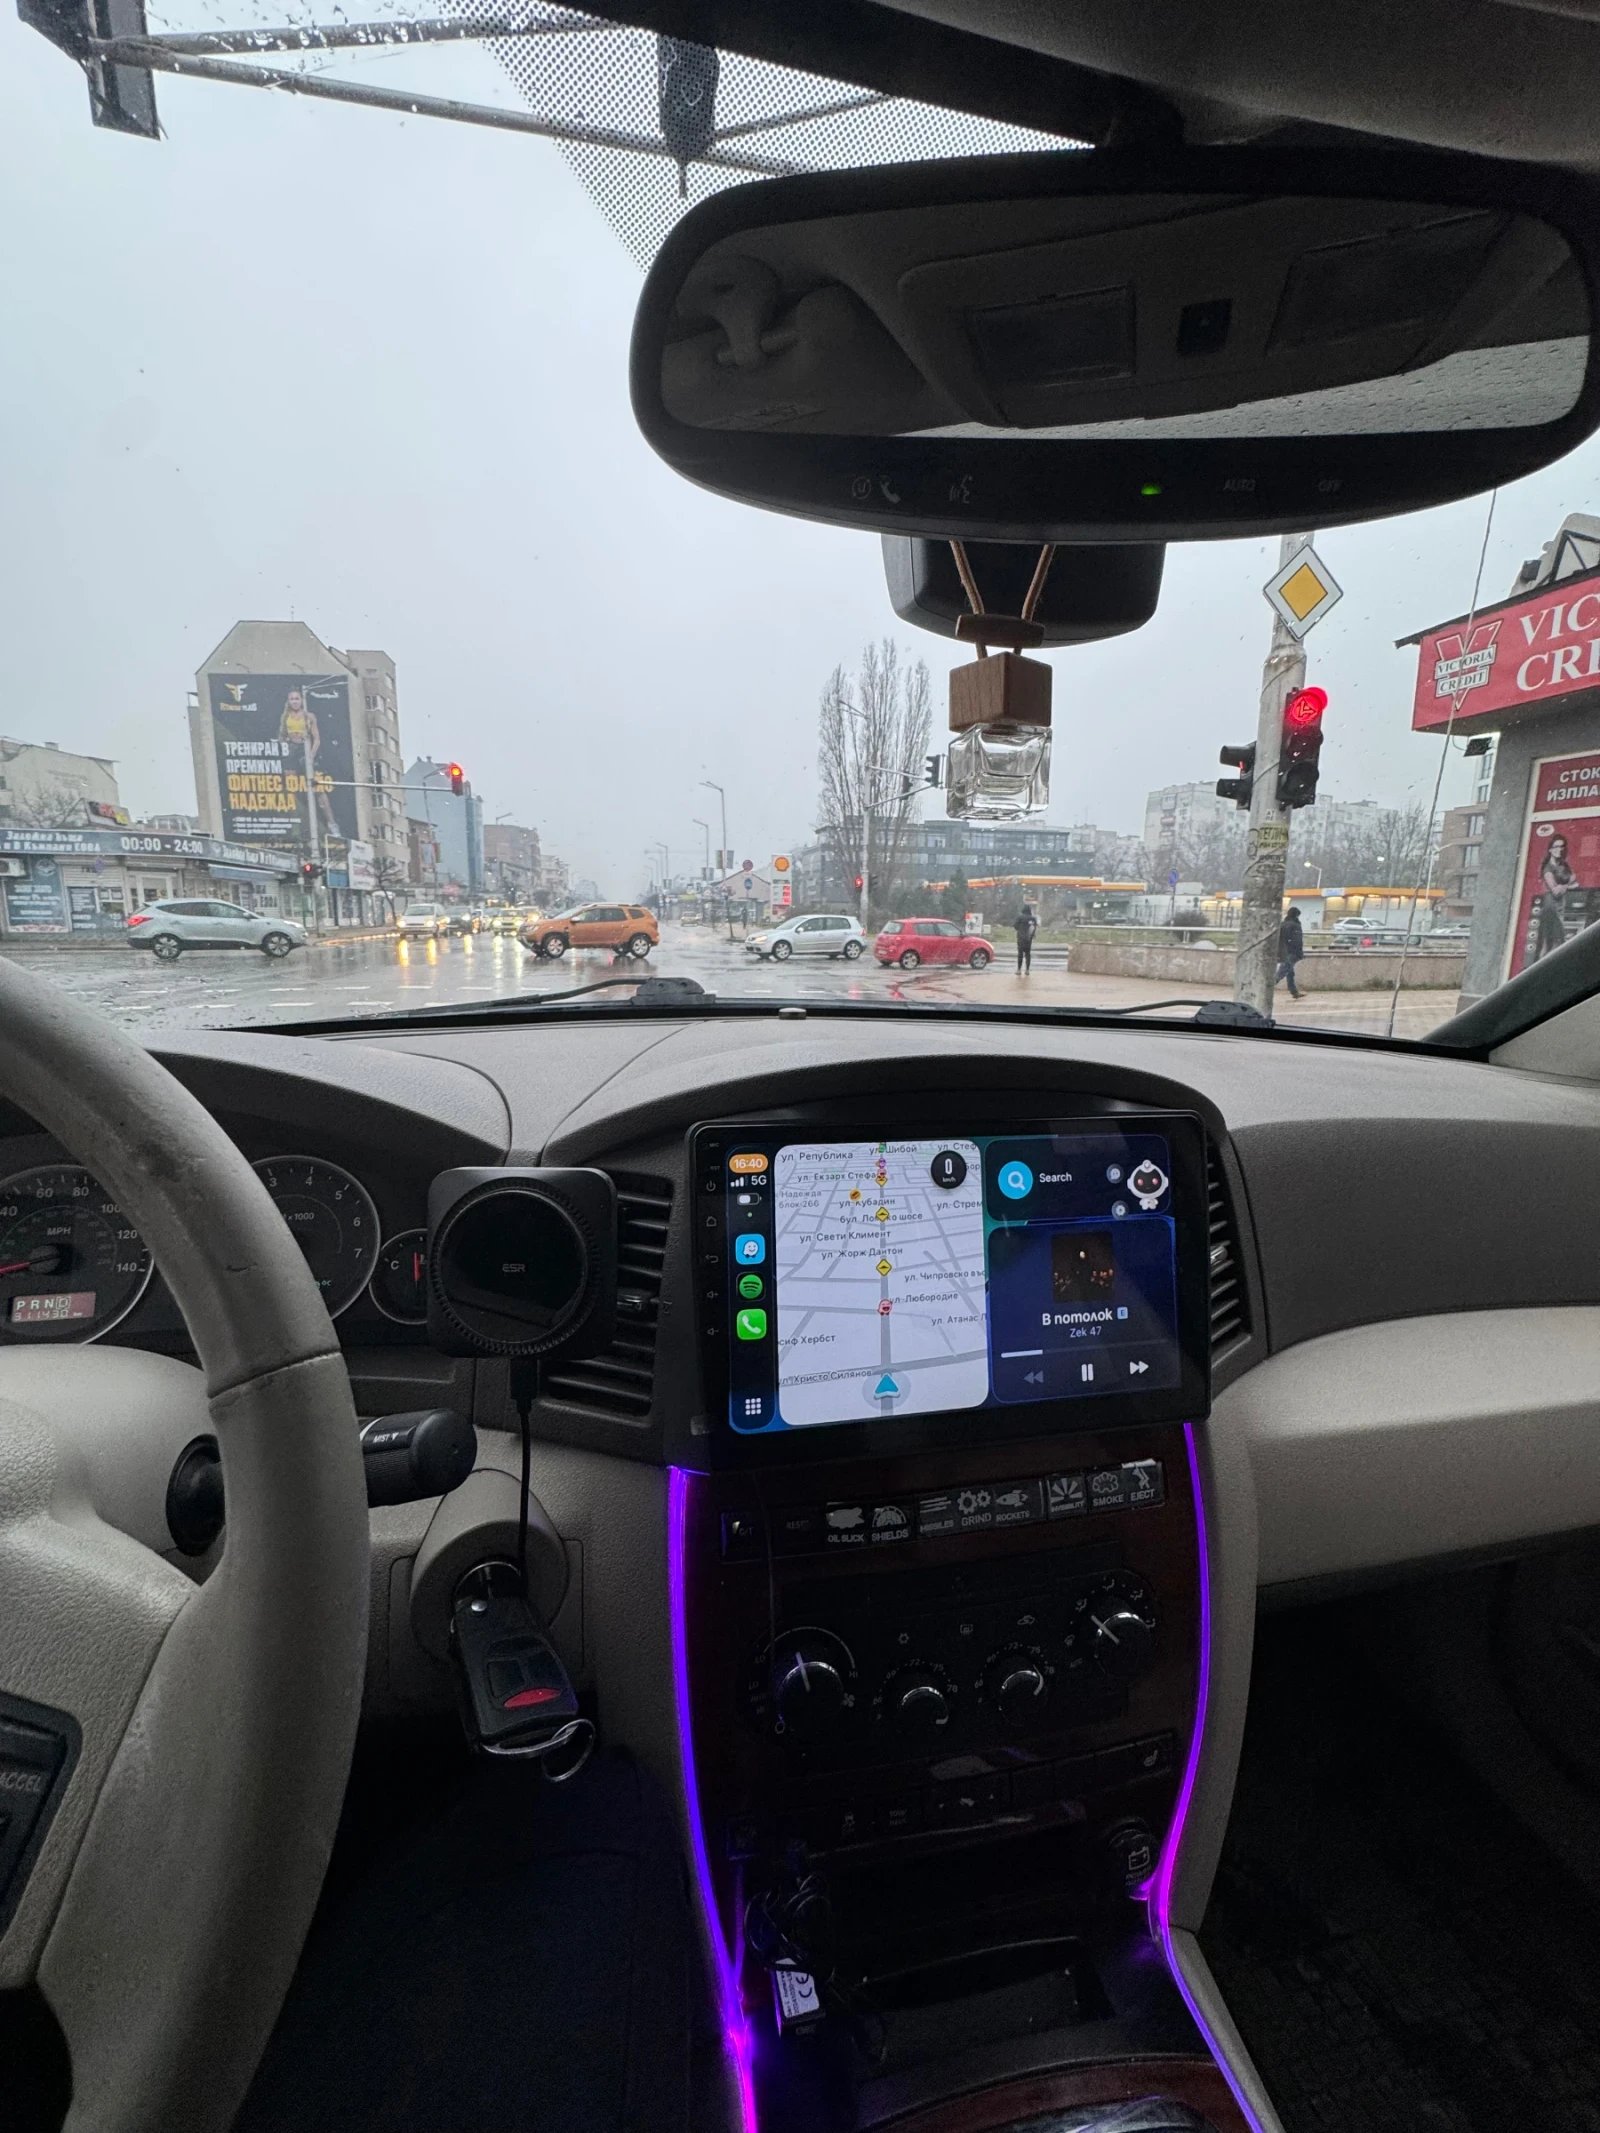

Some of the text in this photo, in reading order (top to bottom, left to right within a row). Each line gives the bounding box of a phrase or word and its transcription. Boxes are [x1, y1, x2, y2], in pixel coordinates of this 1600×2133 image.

[1438, 650, 1493, 674] VICTORIA
[1440, 671, 1485, 692] CREDIT
[224, 738, 290, 757] ТРЕНИРАЙ В
[226, 759, 282, 775] ПРЕМИУМ
[228, 775, 283, 793] ФИТНЕС
[1547, 784, 1600, 802] ИЗПЛА
[229, 792, 297, 812] НАДЕЖДА
[120, 836, 161, 851] 00:00
[174, 839, 204, 854] 24:00
[800, 1151, 854, 1162] Република
[733, 1158, 764, 1169] 16:40
[944, 1158, 953, 1175] 0
[269, 1177, 278, 1187] 3
[305, 1176, 313, 1186] 4
[751, 1175, 767, 1185] 5G
[813, 1172, 845, 1182] Екзарх
[847, 1171, 876, 1180] Стефа
[1039, 1172, 1073, 1183] Search
[36, 1187, 53, 1198] 60
[72, 1186, 89, 1197] 80
[335, 1190, 343, 1201] 5
[781, 1190, 822, 1199] Надежда
[779, 1200, 820, 1208] блок 266
[855, 1198, 896, 1207] Кубадин
[0, 1205, 18, 1217] 40
[294, 1211, 315, 1221] 1000
[899, 1212, 923, 1221] шосе
[353, 1216, 361, 1227] 6
[46, 1227, 72, 1236] MPH
[117, 1229, 138, 1240] 120
[816, 1232, 847, 1242] Свети
[848, 1231, 891, 1240] Климент
[353, 1248, 363, 1259] 7
[838, 1249, 867, 1259] Жорж
[868, 1247, 903, 1257] Дантон
[116, 1262, 138, 1273] 140
[390, 1260, 400, 1271] C
[502, 1263, 526, 1273] ESR
[919, 1270, 969, 1281] Чипровско
[905, 1292, 958, 1303] Любородие
[16, 1300, 26, 1310] P
[30, 1299, 41, 1310] R
[44, 1299, 54, 1309] N
[947, 1314, 979, 1324] Атанас
[1042, 1313, 1052, 1326] В
[1069, 1325, 1102, 1338] Zek 47
[800, 1334, 836, 1346] Хербст
[793, 1373, 829, 1385] Христо
[830, 1370, 872, 1381] Силянов
[1092, 1493, 1125, 1507] SMOKE
[1130, 1488, 1156, 1502] EJECT
[961, 1512, 992, 1528] GRIND
[996, 1510, 1031, 1523] ROCKETS
[919, 1519, 955, 1533] MISSILES
[827, 1533, 864, 1543] OIL SLICK
[871, 1528, 909, 1542] SHIELDS
[1008, 1641, 1019, 1650] 72
[1044, 1666, 1056, 1675] 78
[946, 1684, 958, 1694] 78
[0, 1771, 42, 1792] ACCEL
[796, 1972, 813, 1999] CE
